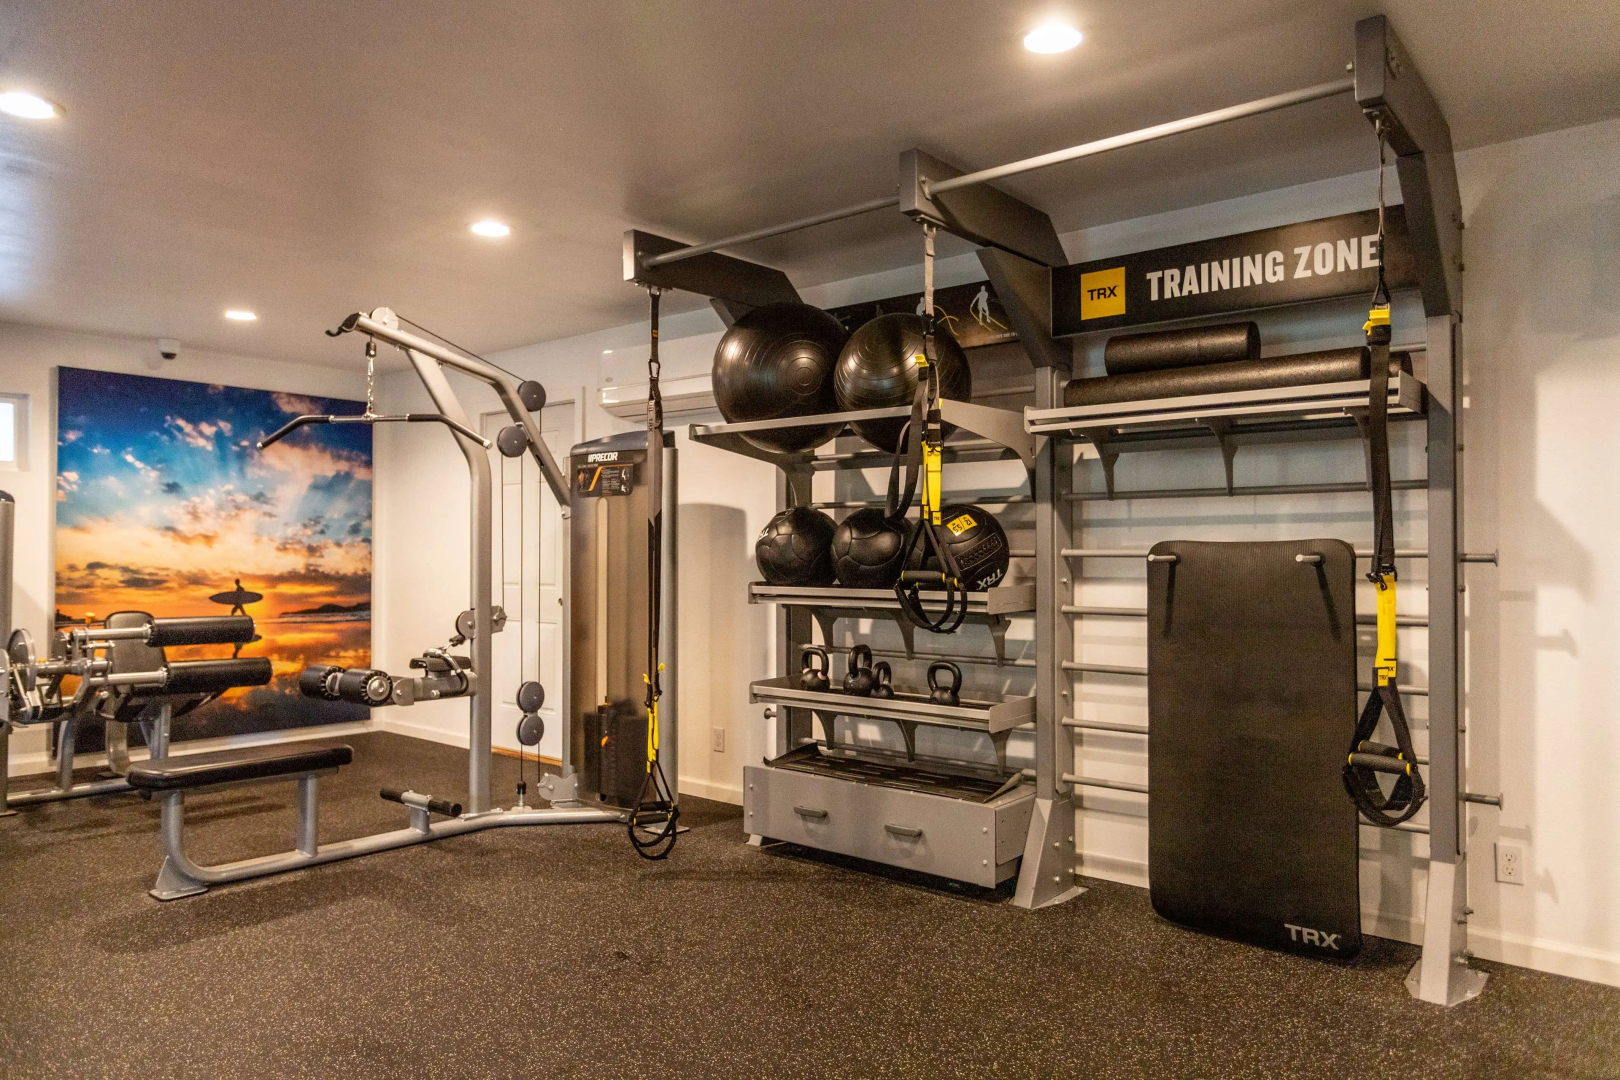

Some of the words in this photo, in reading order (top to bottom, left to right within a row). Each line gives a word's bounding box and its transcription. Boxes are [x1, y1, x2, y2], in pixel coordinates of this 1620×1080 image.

[1146, 250, 1284, 301] TRAINING
[1293, 233, 1380, 279] ZONE
[1087, 285, 1118, 301] TRX
[591, 451, 618, 462] PRECOR
[976, 568, 1003, 590] TRX
[1283, 923, 1340, 951] TRX
